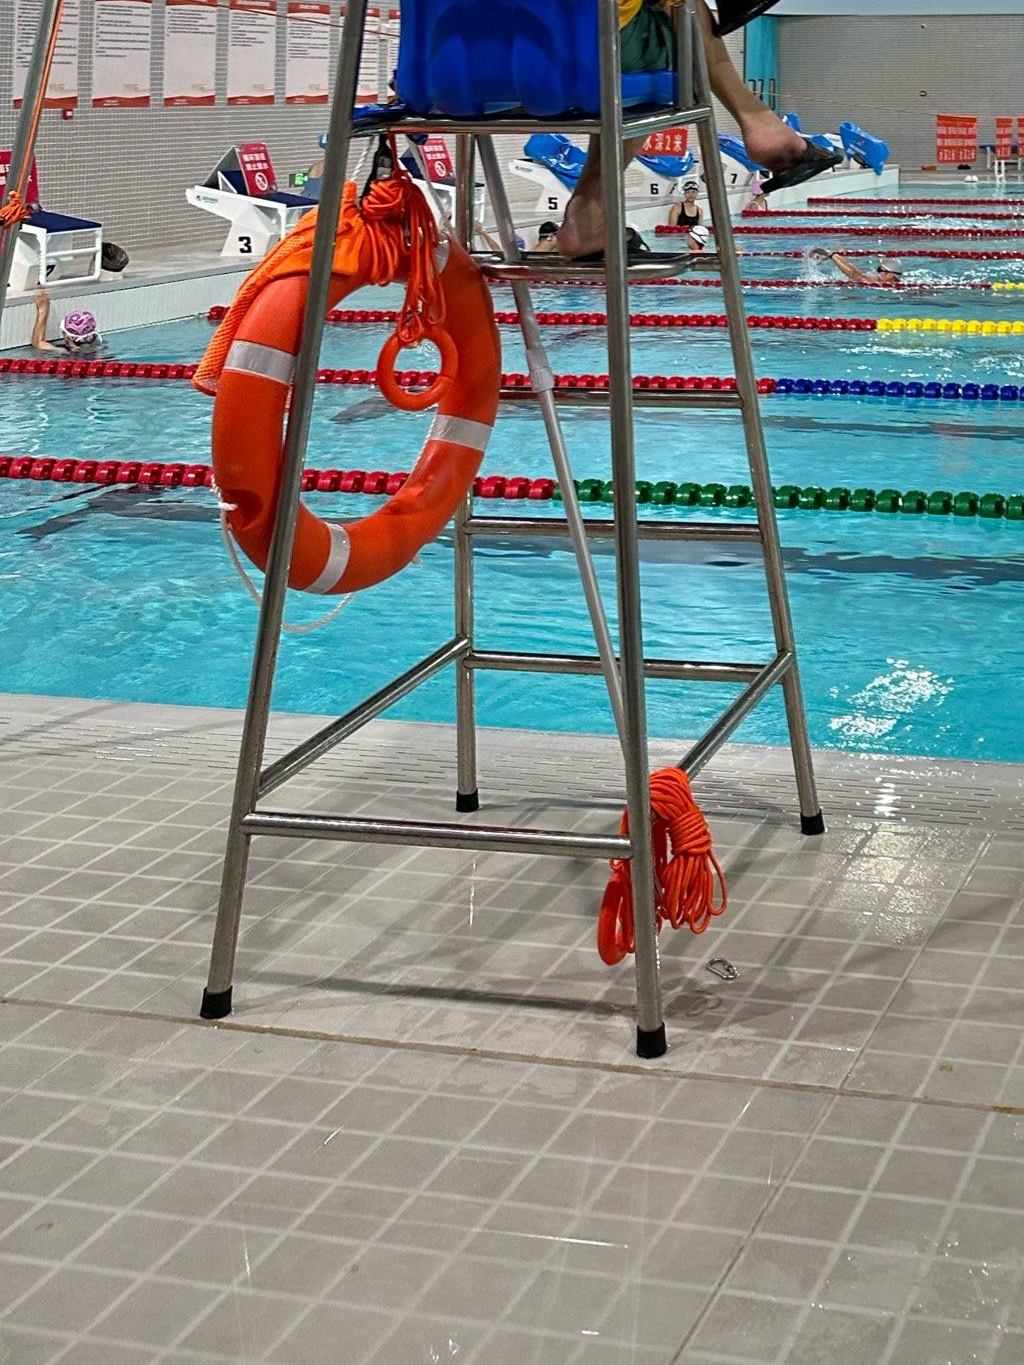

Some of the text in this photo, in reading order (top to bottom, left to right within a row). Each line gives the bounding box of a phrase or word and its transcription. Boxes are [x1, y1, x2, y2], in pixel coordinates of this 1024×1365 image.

[642, 133, 683, 151] 水深2米
[731, 173, 738, 184] 7
[650, 183, 659, 195] 6
[548, 197, 558, 210] 5
[238, 236, 252, 253] 3
